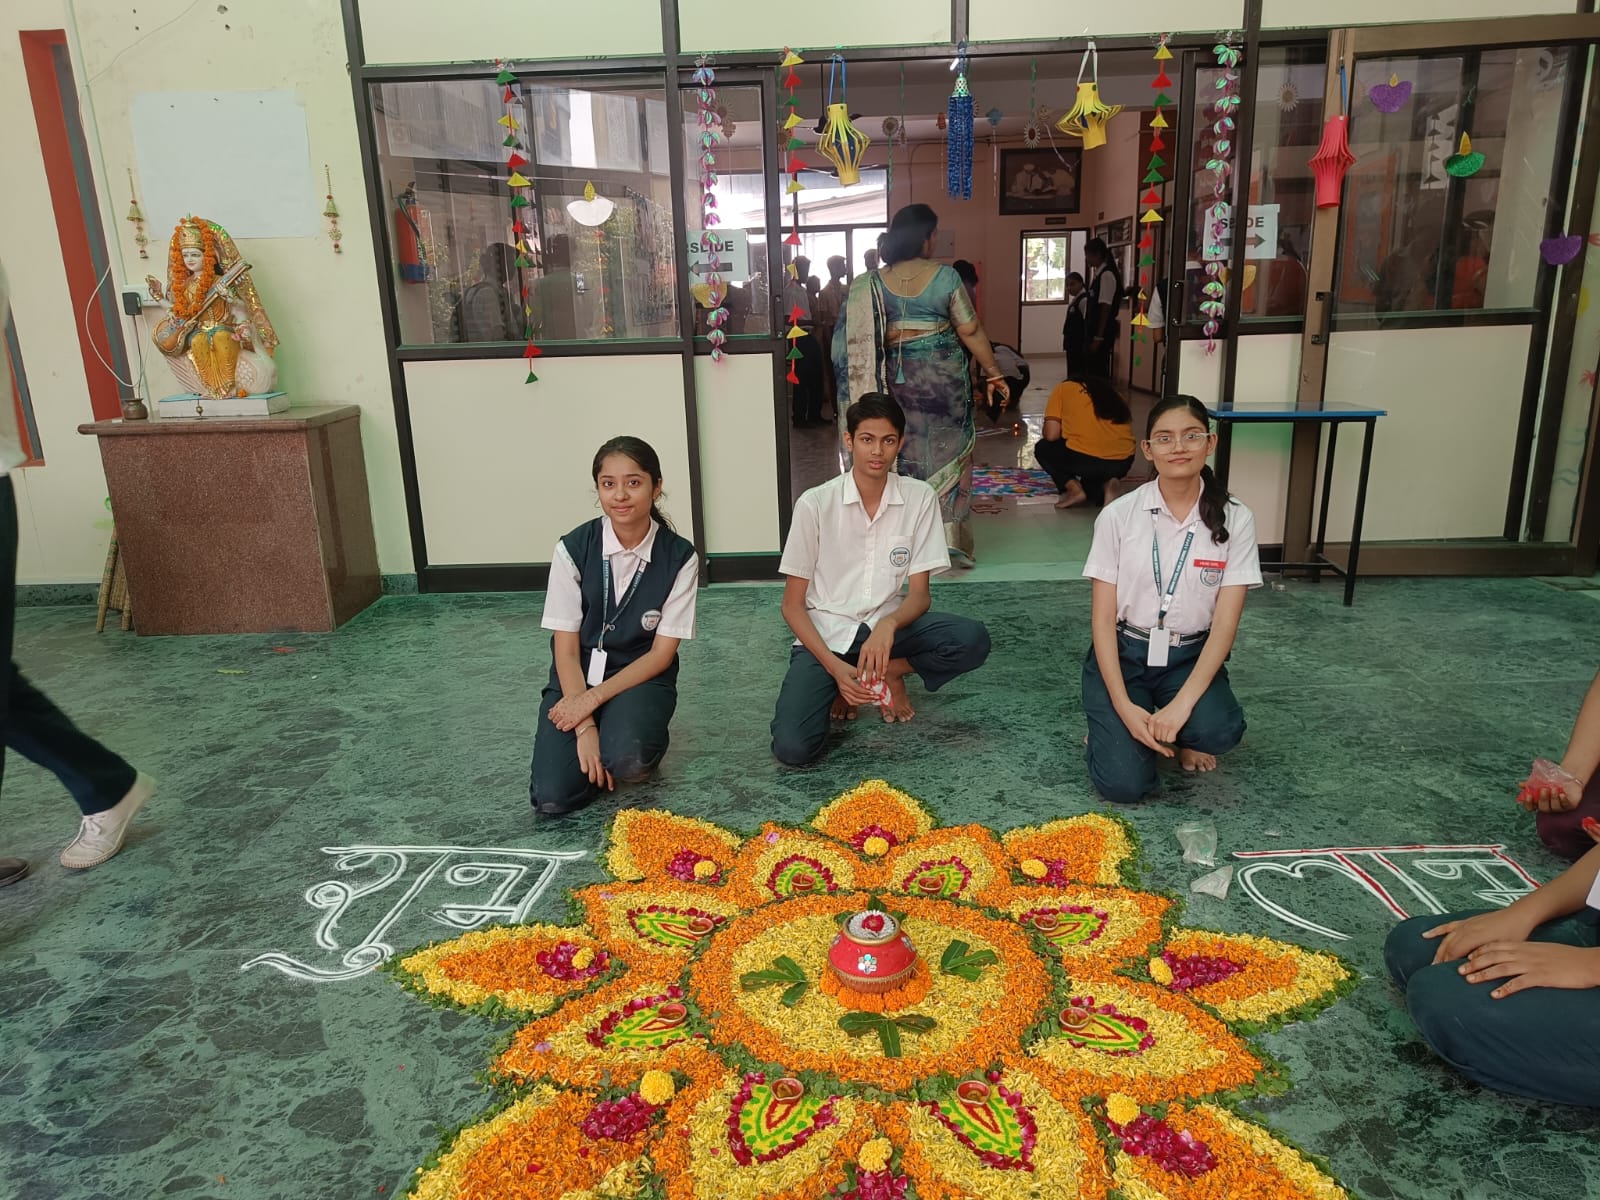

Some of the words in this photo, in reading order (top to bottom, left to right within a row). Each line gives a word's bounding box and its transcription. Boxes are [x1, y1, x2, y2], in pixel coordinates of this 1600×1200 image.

[1221, 216, 1264, 229] SDE
[241, 846, 587, 981] शुभ
[1232, 844, 1543, 941] लाभ
